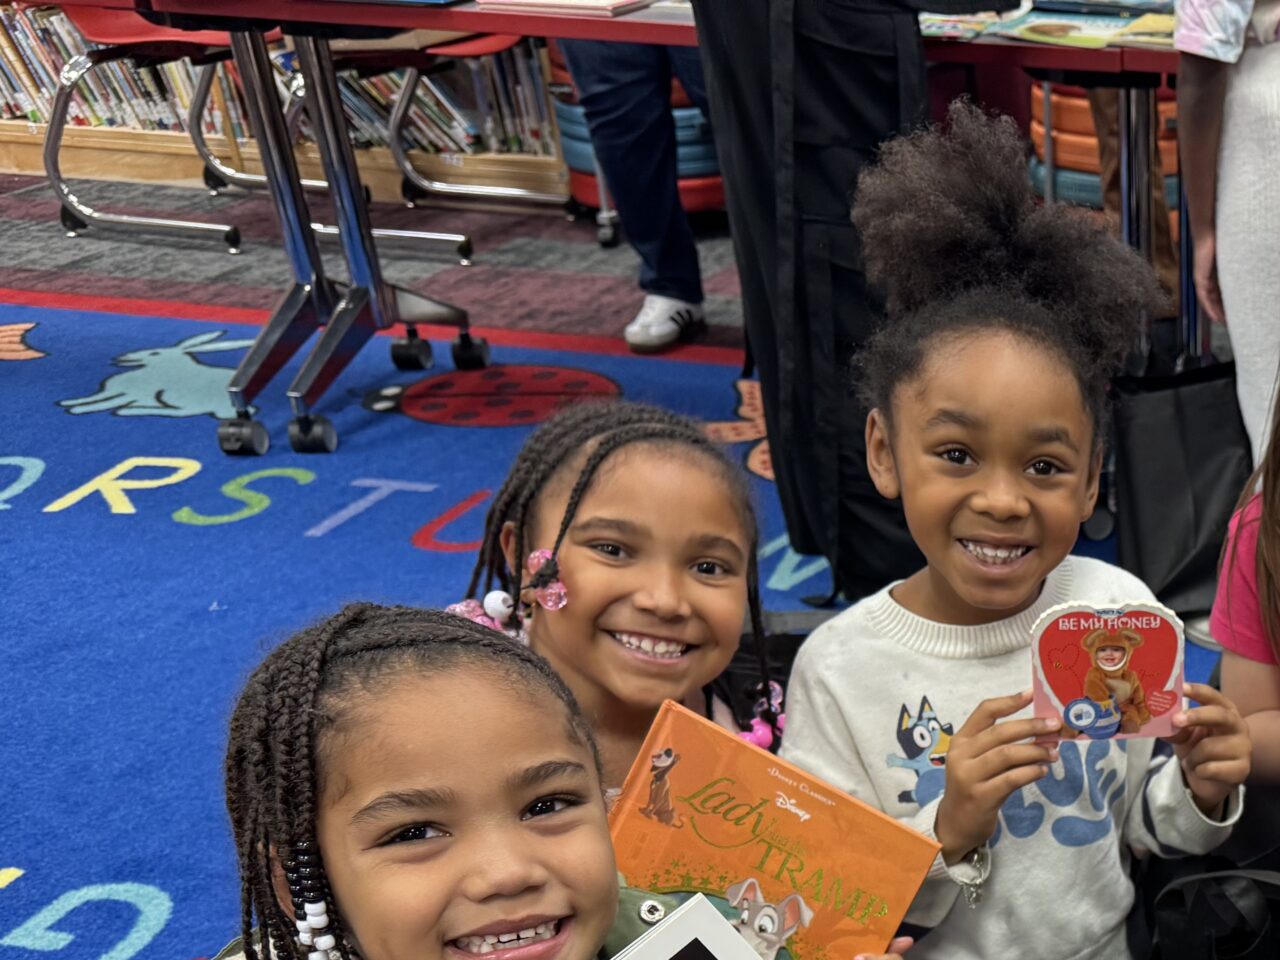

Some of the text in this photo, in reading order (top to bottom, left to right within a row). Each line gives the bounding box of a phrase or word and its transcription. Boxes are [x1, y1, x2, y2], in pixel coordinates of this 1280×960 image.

[1058, 616, 1161, 631] BE MY HONEY
[677, 777, 772, 848] Lady
[752, 838, 888, 925] TRAMP
